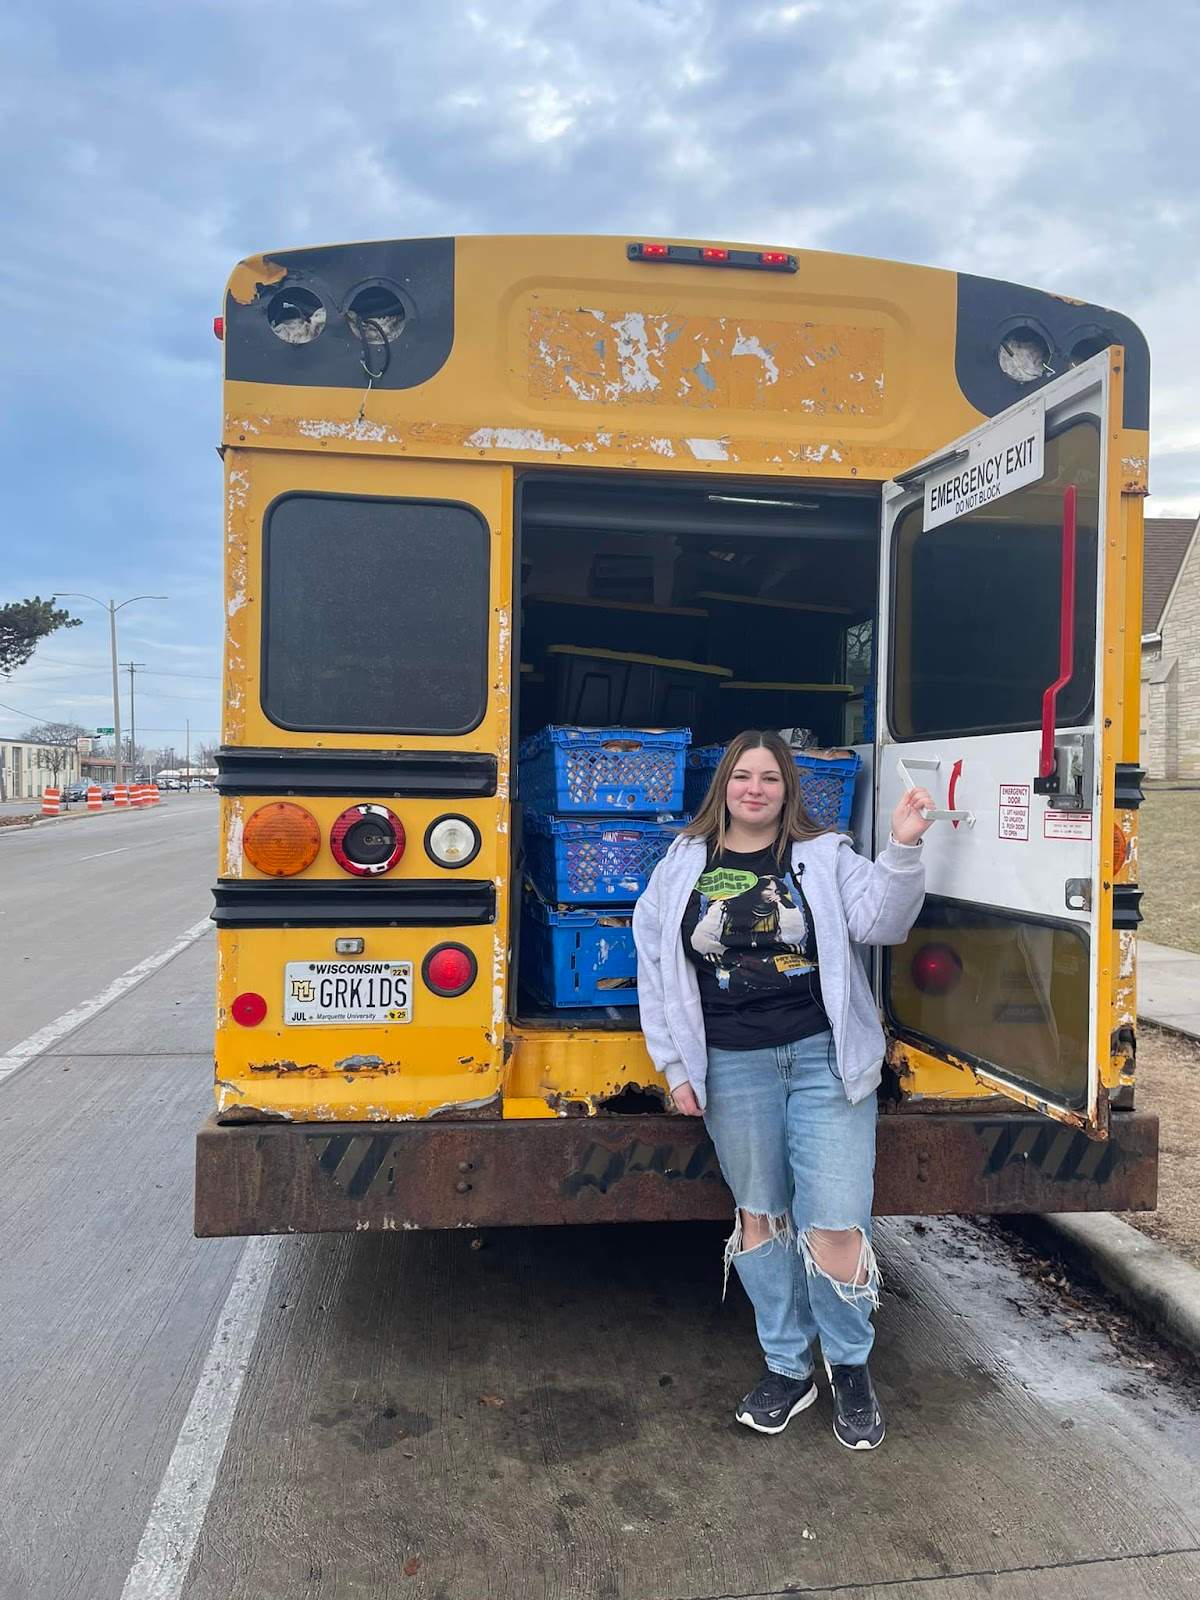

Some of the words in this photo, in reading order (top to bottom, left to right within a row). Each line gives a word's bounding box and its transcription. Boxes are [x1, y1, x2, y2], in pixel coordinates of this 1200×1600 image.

[930, 453, 1003, 511] EMERGENCY
[1006, 436, 1035, 475] EXIT
[955, 501, 965, 515] DO
[966, 495, 979, 510] NOT
[978, 482, 1001, 504] BLOCK
[1007, 796, 1021, 804] DOOR
[316, 964, 384, 974] WISCONSIN
[291, 980, 316, 1003] MU
[320, 977, 407, 1008] GRK1DS
[291, 1012, 307, 1022] JUL
[316, 1013, 346, 1021] Marquette
[346, 1012, 376, 1021] University
[397, 1011, 406, 1019] 25
